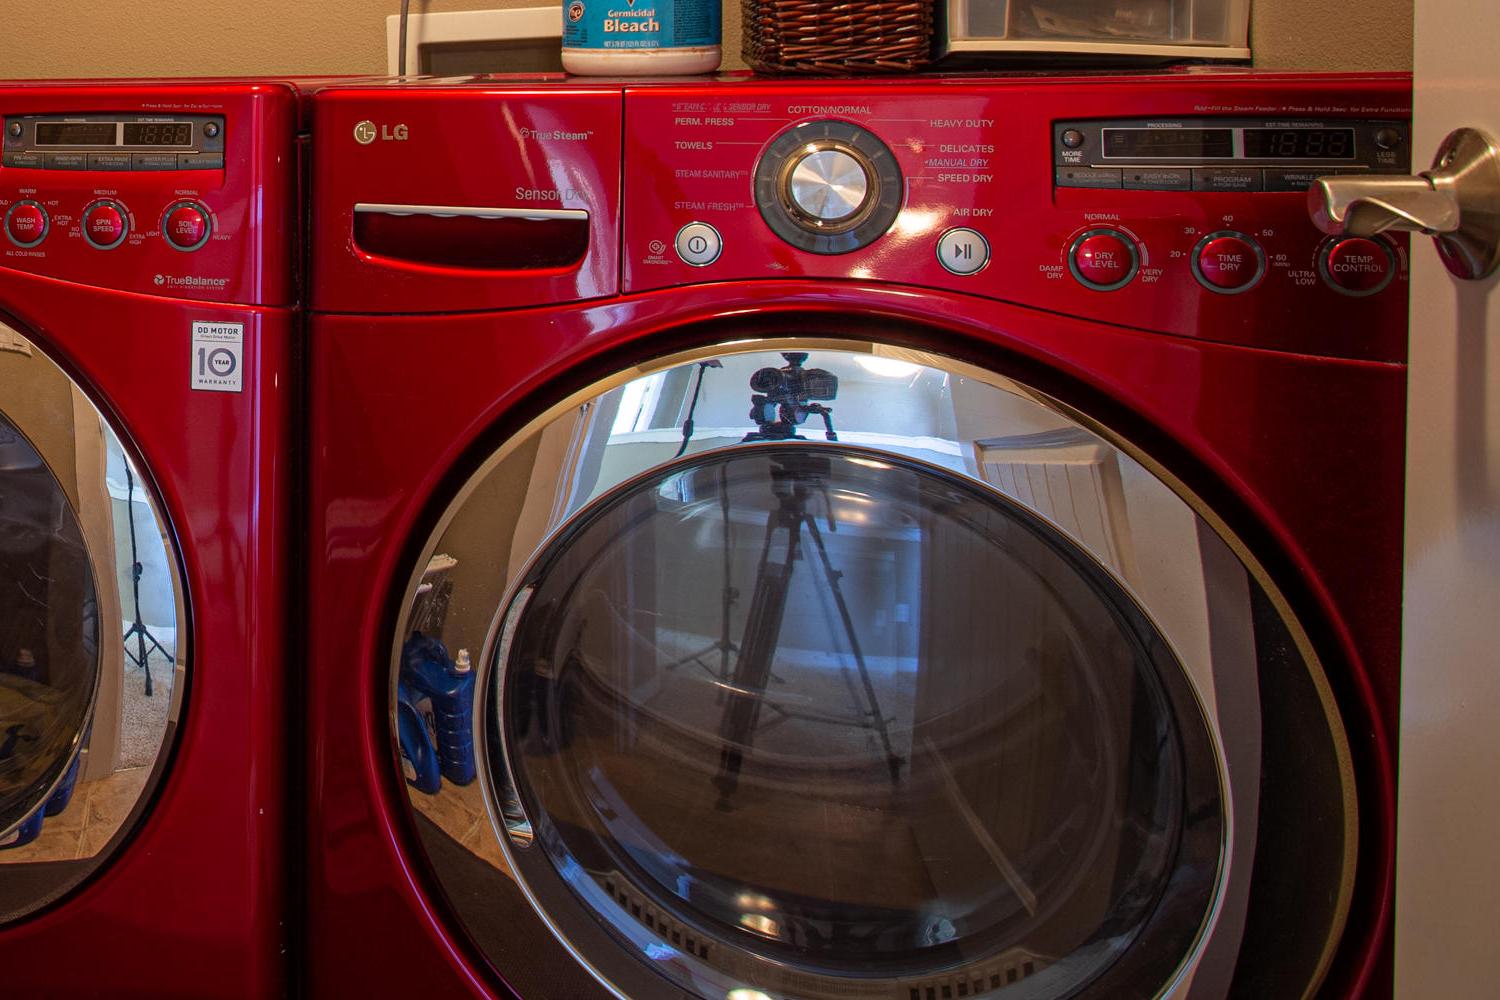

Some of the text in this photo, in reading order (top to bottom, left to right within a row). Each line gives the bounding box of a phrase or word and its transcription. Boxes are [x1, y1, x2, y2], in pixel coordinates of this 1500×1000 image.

[607, 8, 655, 18] Germicidal
[604, 18, 660, 32] Bleach
[729, 103, 756, 111] SENSOR
[756, 103, 772, 111] DRY
[787, 105, 872, 115] COTTON/NORMAL
[705, 118, 734, 126] PRESS
[930, 119, 994, 128] HEAVY DUTY
[381, 124, 409, 141] LG
[675, 141, 713, 150] TOWELS
[939, 144, 995, 153] DELICATES
[970, 158, 989, 167] DRY
[675, 169, 701, 178] STEAM
[937, 174, 994, 183] SPEED DRY
[515, 186, 561, 201] Sensor
[674, 201, 706, 210] STEAM
[953, 208, 994, 217] AIR DRY
[1084, 213, 1121, 221] NORMAL
[1094, 252, 1115, 260] DRY
[1217, 254, 1243, 263] TIME
[1090, 260, 1120, 268] LEVEL
[1219, 263, 1242, 271] DRY
[1333, 263, 1384, 273] CONTROL
[1288, 270, 1316, 278] ULTRA
[197, 326, 238, 335] DD MOTOR
[197, 347, 237, 377] 10
